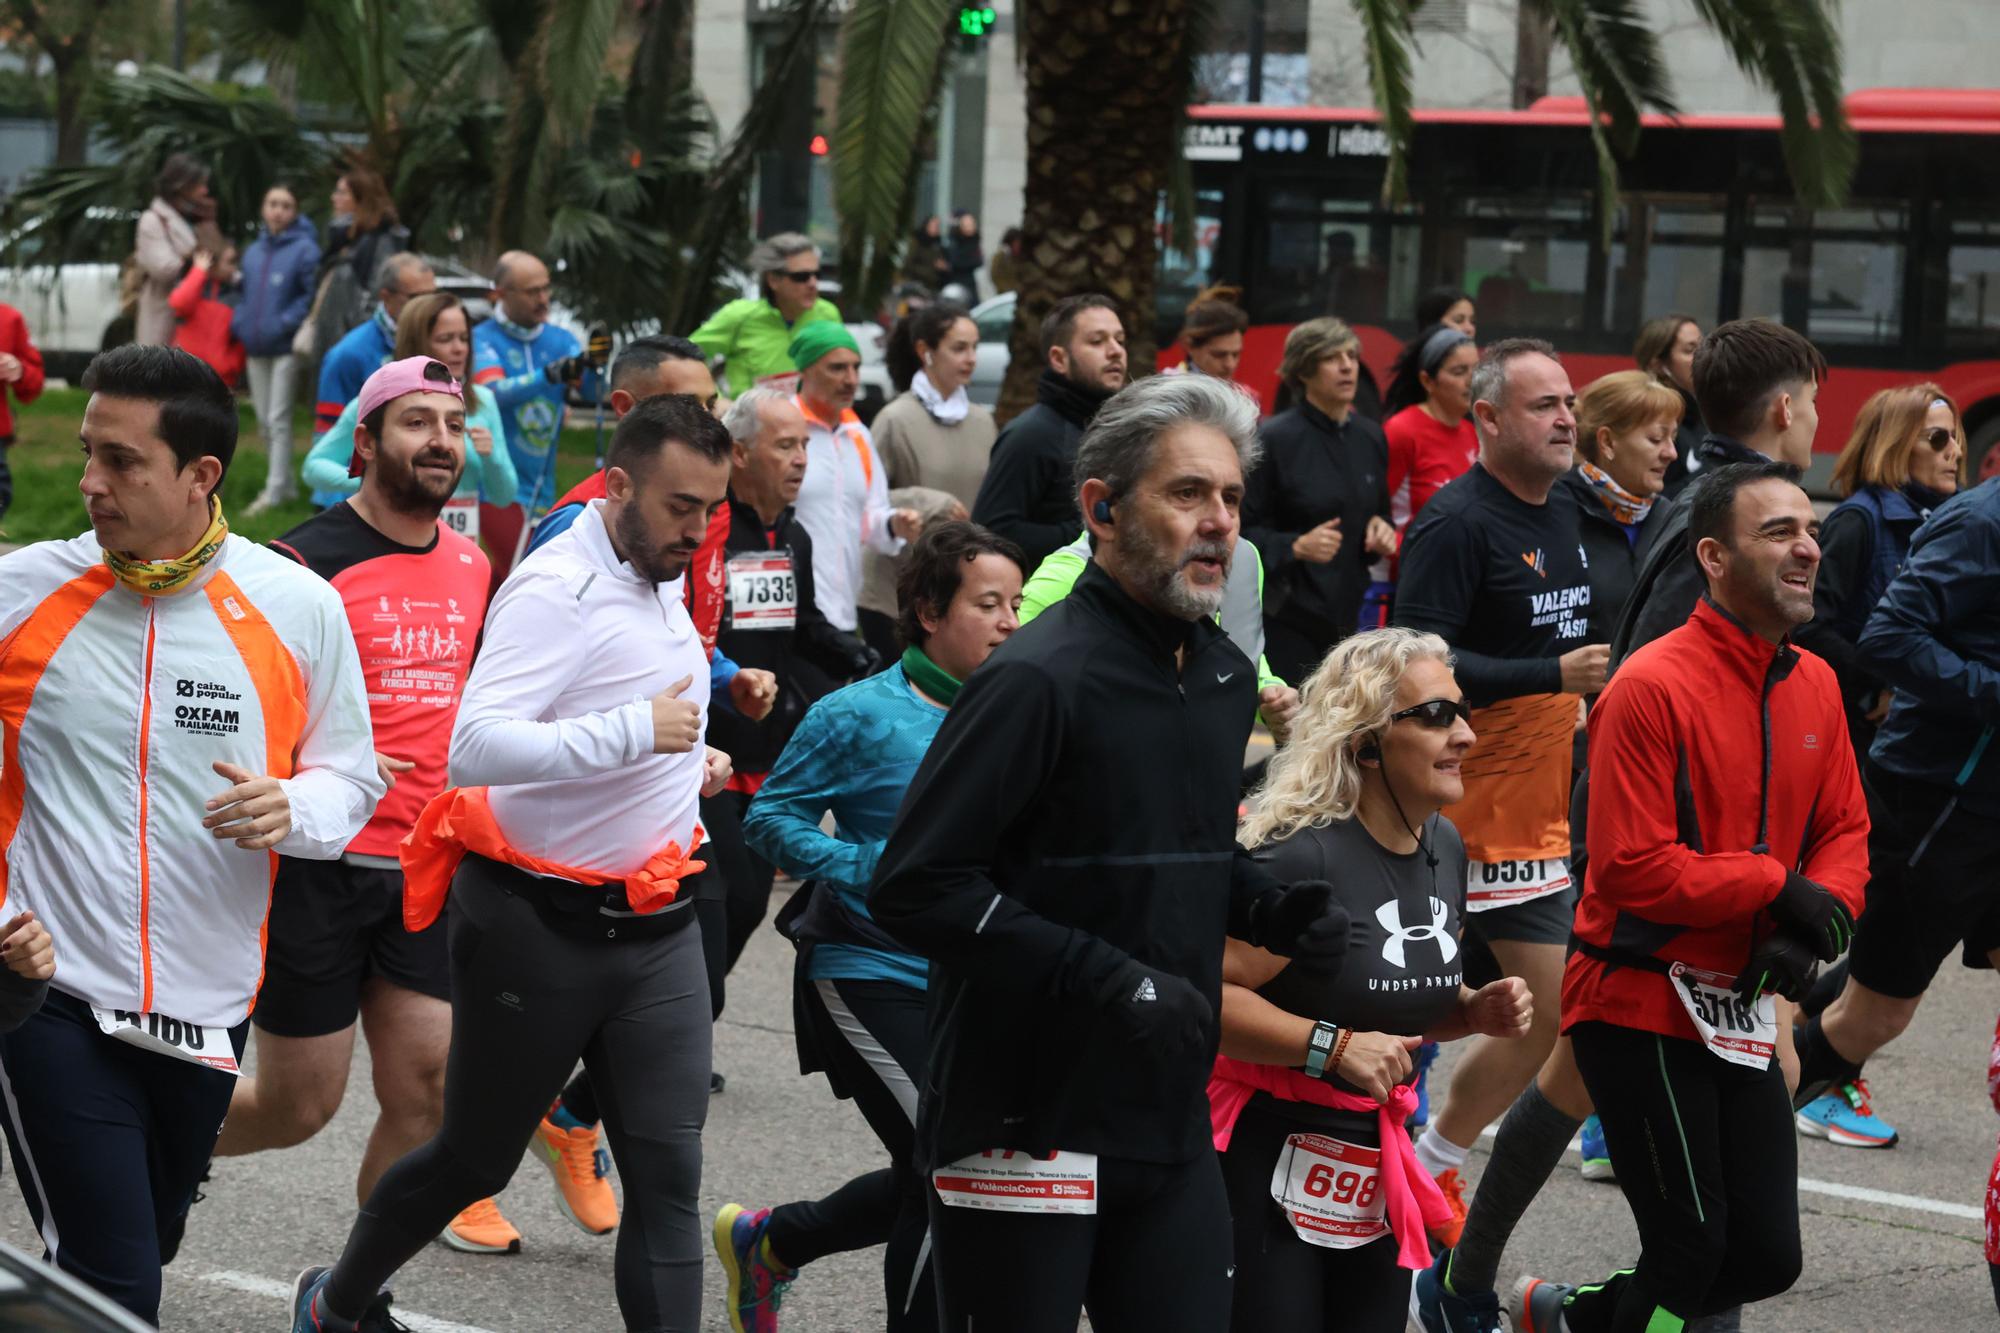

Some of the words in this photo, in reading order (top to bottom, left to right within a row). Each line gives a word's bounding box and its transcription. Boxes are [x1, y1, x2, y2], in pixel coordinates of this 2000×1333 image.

[1183, 125, 1244, 146] EMT
[440, 512, 467, 532] 49
[743, 576, 794, 604] 7335
[197, 682, 226, 692] caixa
[416, 680, 432, 690] DEL
[196, 690, 242, 701] popular
[175, 705, 239, 725] OXFAM
[174, 720, 239, 733] TRAILWALKER
[1369, 978, 1418, 992] UNDER
[1690, 990, 1755, 1034] 5718
[991, 1168, 1006, 1177] Stop
[970, 1181, 1046, 1195] #ValènciaCorre
[1303, 1163, 1380, 1208] 698
